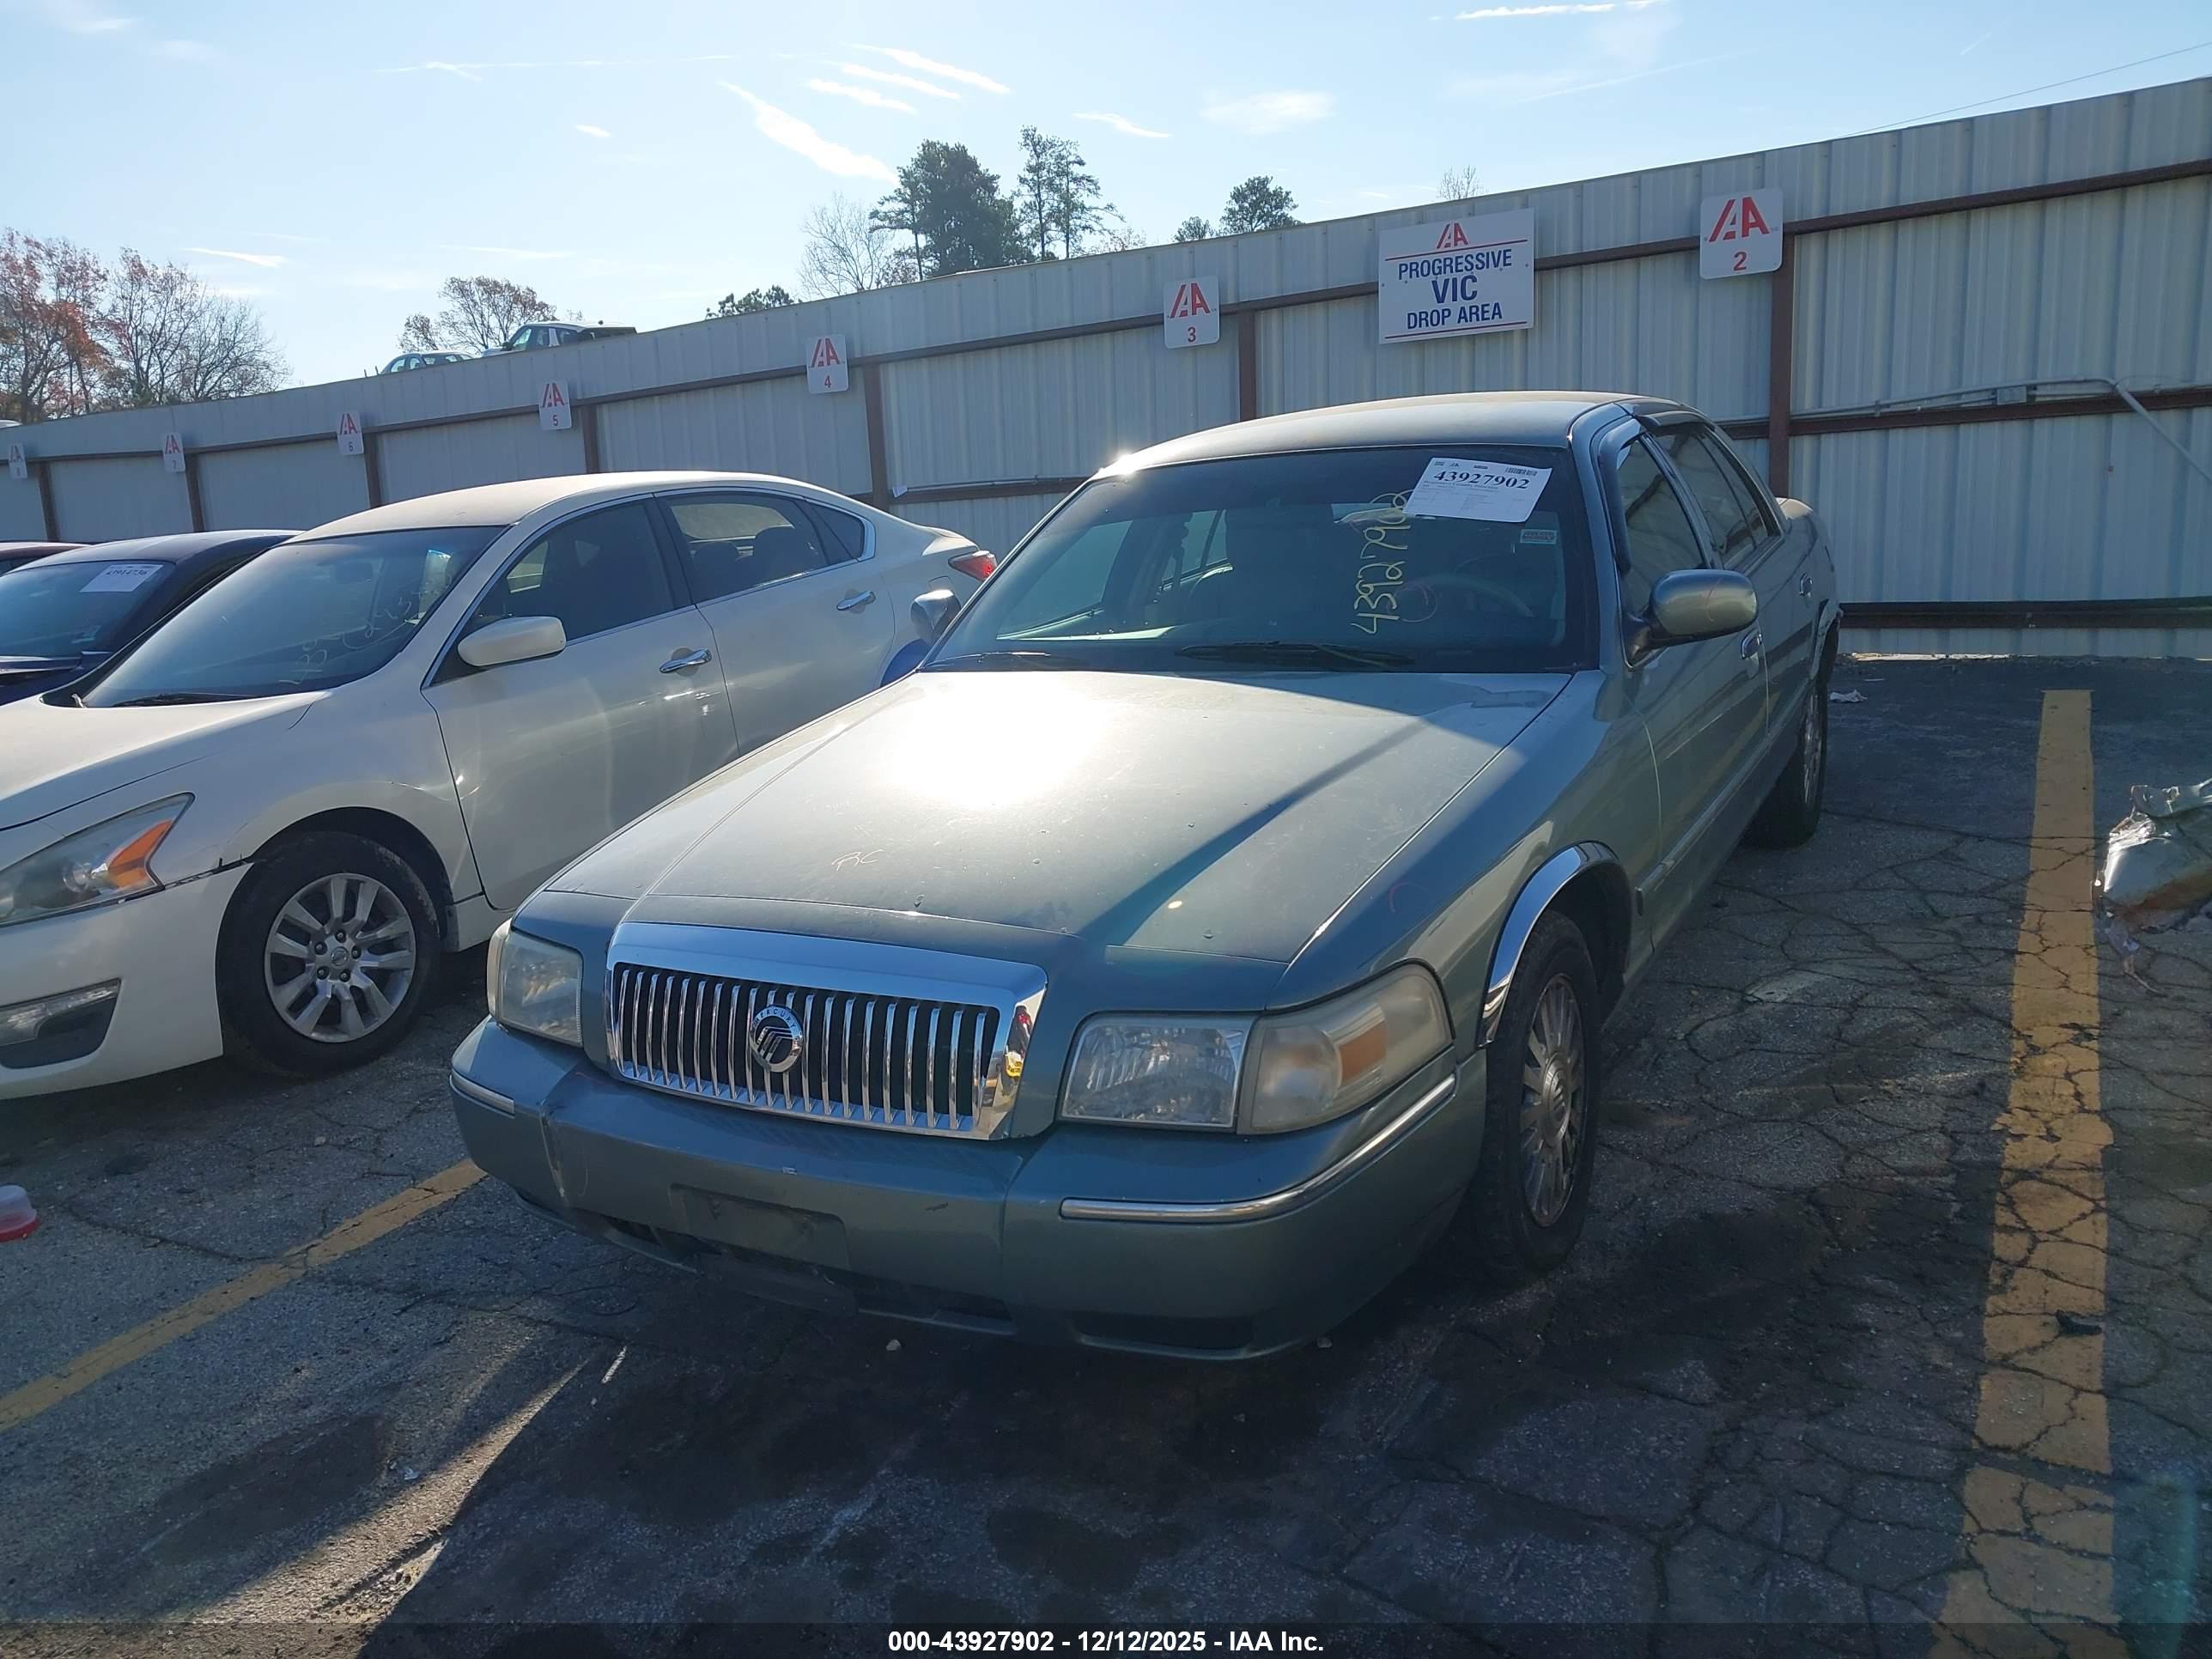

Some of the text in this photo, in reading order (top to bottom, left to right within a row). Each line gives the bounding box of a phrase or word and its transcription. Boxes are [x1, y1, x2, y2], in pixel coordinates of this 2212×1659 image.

[1398, 248, 1512, 280] PROGRESSIVE
[1734, 252, 1747, 271] 2
[1431, 274, 1478, 304] VIC
[1407, 301, 1503, 330] DROP AREA
[1188, 326, 1196, 343] 3
[824, 375, 831, 388] 4
[552, 414, 558, 427] 5
[1433, 471, 1530, 489] 43927902
[752, 1008, 798, 1028] MERCURY
